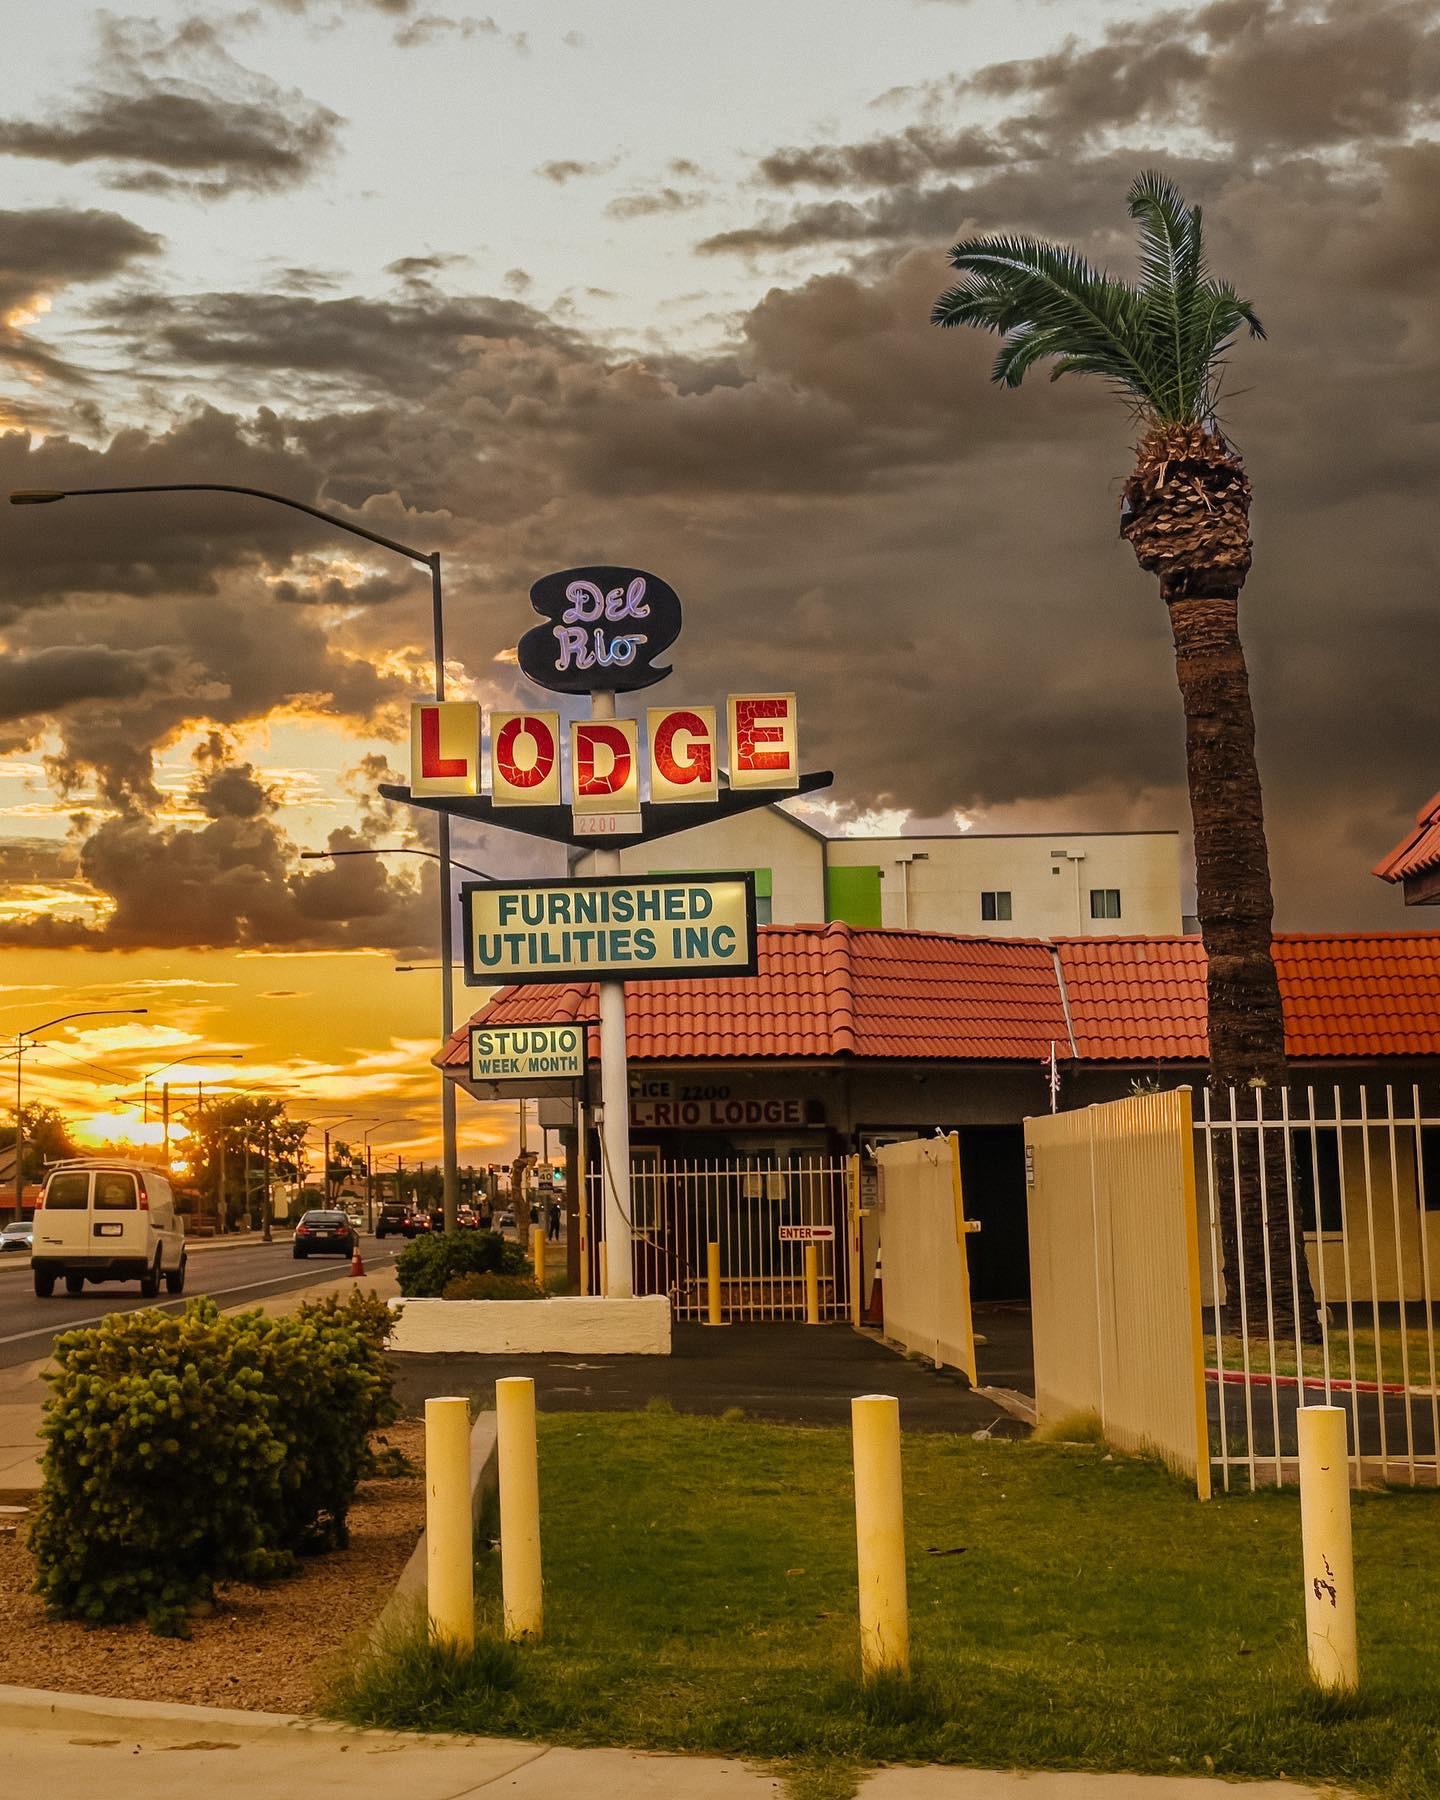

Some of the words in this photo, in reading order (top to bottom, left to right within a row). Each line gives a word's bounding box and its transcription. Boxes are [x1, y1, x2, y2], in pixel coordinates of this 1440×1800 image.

[562, 576, 651, 623] Del
[552, 624, 648, 672] Rio
[420, 699, 791, 796] LODGE
[579, 816, 616, 833] 2200
[498, 888, 714, 926] FURNISHED
[478, 928, 657, 966] UTILITIES
[672, 925, 736, 959] INC
[477, 1030, 577, 1056] STUDIO
[478, 1056, 578, 1074] WEEK/MONTH
[709, 1100, 800, 1124] LODGE
[780, 1227, 812, 1239] ENTER
